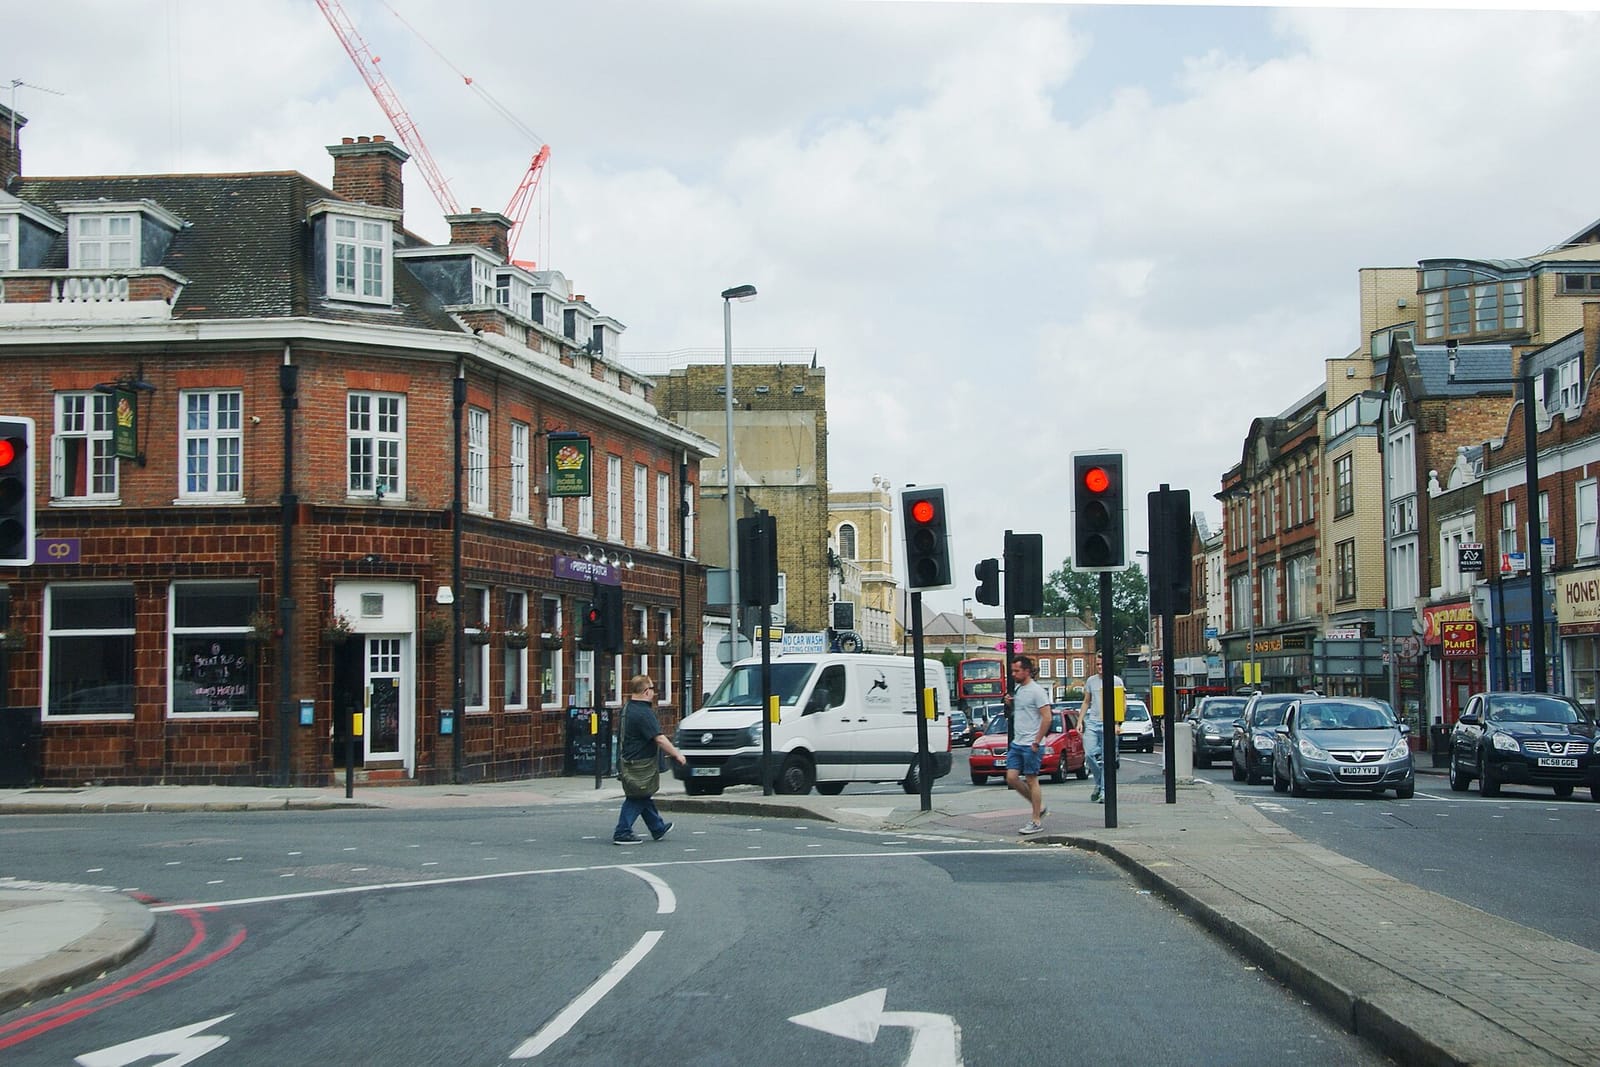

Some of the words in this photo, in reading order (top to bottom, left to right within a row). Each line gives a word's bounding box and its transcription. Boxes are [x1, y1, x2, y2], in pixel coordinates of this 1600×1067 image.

[573, 560, 591, 573] PURPLE
[1566, 579, 1600, 604] HONEY
[1445, 623, 1474, 633] RED
[793, 635, 805, 646] CAR
[806, 635, 824, 646] WASH
[1444, 639, 1476, 649] PLANET
